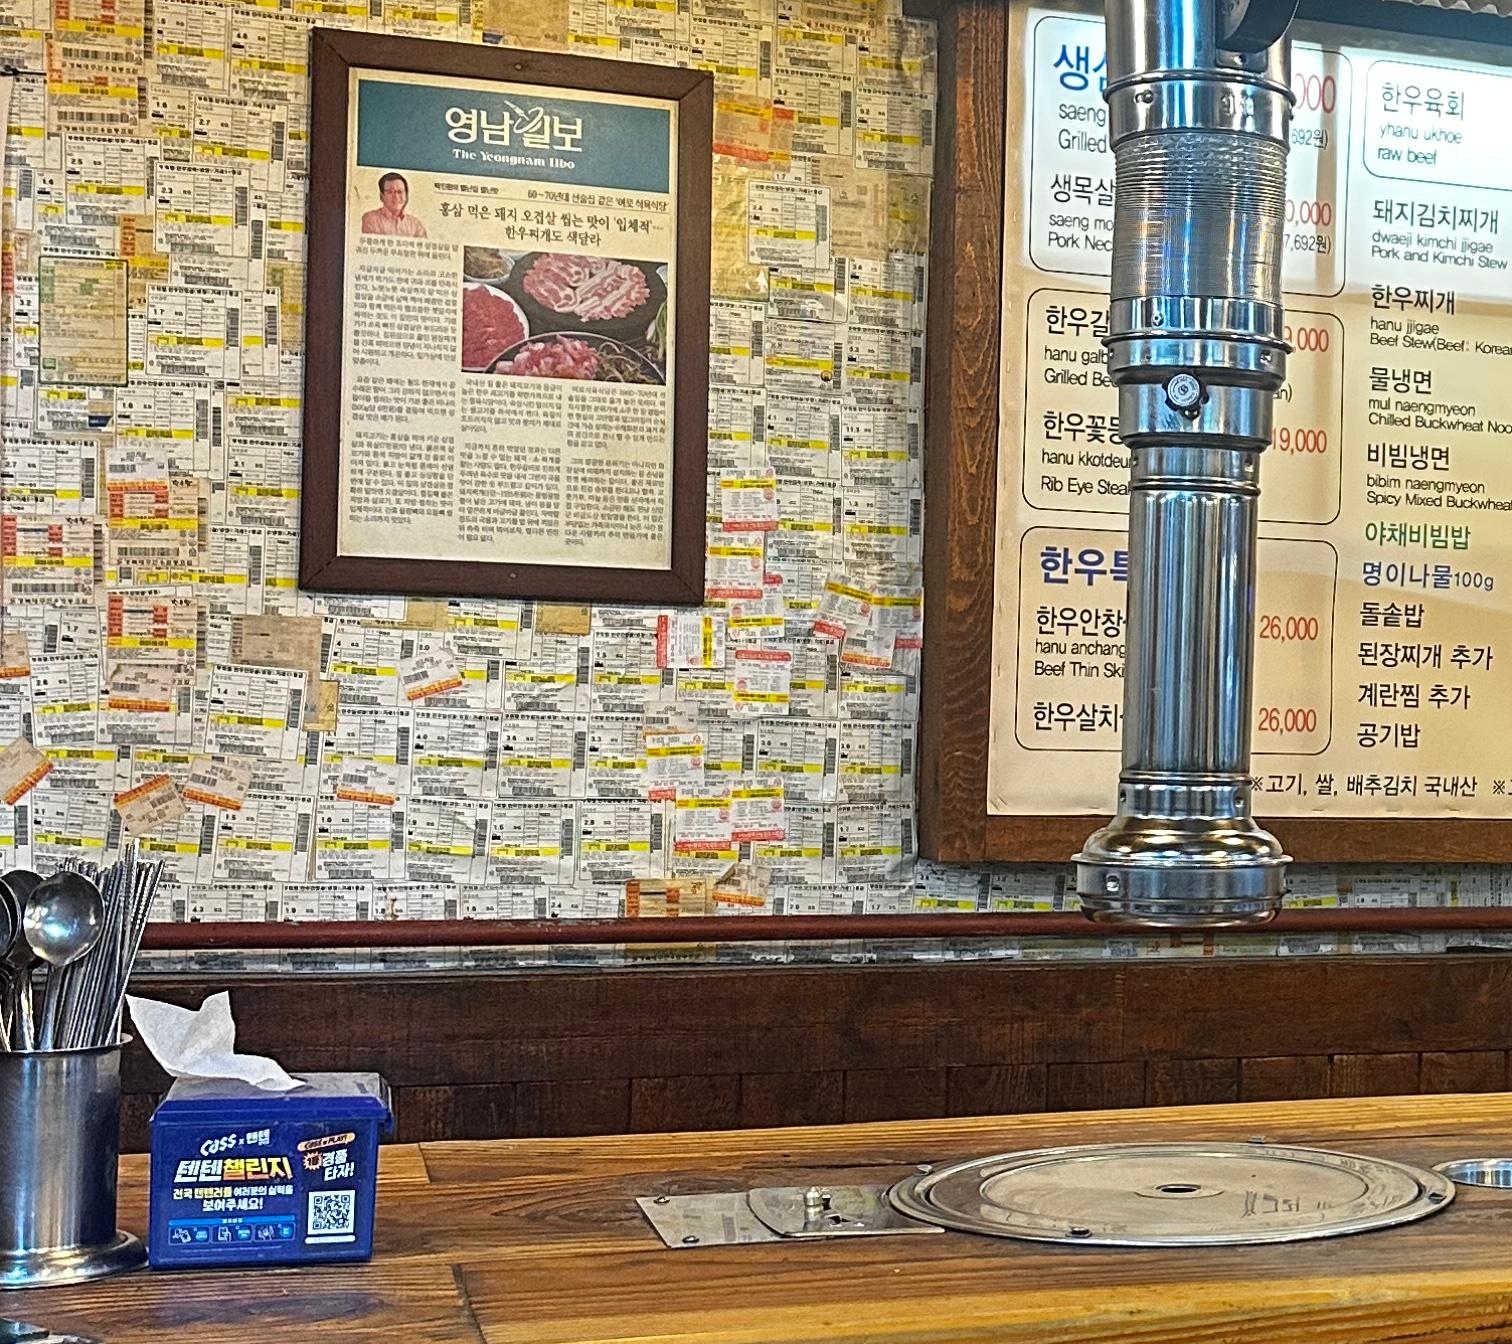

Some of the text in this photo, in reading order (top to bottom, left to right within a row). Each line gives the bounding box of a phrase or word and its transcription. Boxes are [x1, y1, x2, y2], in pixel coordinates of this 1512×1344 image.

[1382, 81, 1465, 121] 한우육회
[1058, 103, 1106, 127] saeng
[1058, 128, 1107, 154] Grilled
[452, 148, 477, 160] The
[480, 150, 546, 167] Yeongnam
[1377, 146, 1438, 165] raw beef
[439, 201, 611, 231] 홍삼 먹은 돼지 오겹살 씹는 맛이
[1048, 214, 1088, 232] saeng
[1372, 199, 1499, 235] 돼지김치찌개
[504, 225, 602, 247] 한우찌개도 색달라
[1048, 232, 1079, 249] Pork
[1371, 230, 1413, 248] dwaeji
[1416, 232, 1457, 250] kimchi
[1371, 245, 1508, 270] Pork and Kimchi Stew
[1371, 284, 1456, 316] 한우찌개
[1370, 316, 1402, 333] hanu
[1370, 333, 1399, 348] Beef
[1044, 345, 1077, 362] hanu
[1044, 368, 1088, 386] Grilled
[1369, 366, 1432, 395] 물냉면
[1369, 397, 1476, 418] mul naengmyeon
[1368, 412, 1411, 428] Chilled
[1415, 415, 1484, 433] Buckwheat
[1041, 448, 1074, 466] hanu
[1367, 442, 1450, 472] 비빔냉면
[1041, 475, 1093, 495] Rib Eye
[1366, 473, 1485, 495] bibim naengmyeon
[1366, 490, 1401, 508] Spicy
[1405, 493, 1442, 509] Mixed
[1365, 520, 1471, 550] 야채비빔밥
[1362, 560, 1494, 592] 명이나물100g
[1360, 602, 1425, 629] 돌솥밥
[1258, 615, 1319, 641] 26,000
[1035, 638, 1067, 654] hanu
[1358, 641, 1443, 669] 된장찌개
[1450, 644, 1493, 670] 추가
[1034, 661, 1099, 678] Beef Thin
[1358, 681, 1420, 709] 계란찜
[1428, 683, 1471, 709] 추가
[1257, 707, 1317, 734] 26,000
[1357, 722, 1420, 748] 공기밥
[1315, 774, 1338, 797] 쌀,
[1346, 774, 1417, 797] 배추김치
[1424, 775, 1478, 798] 국내산
